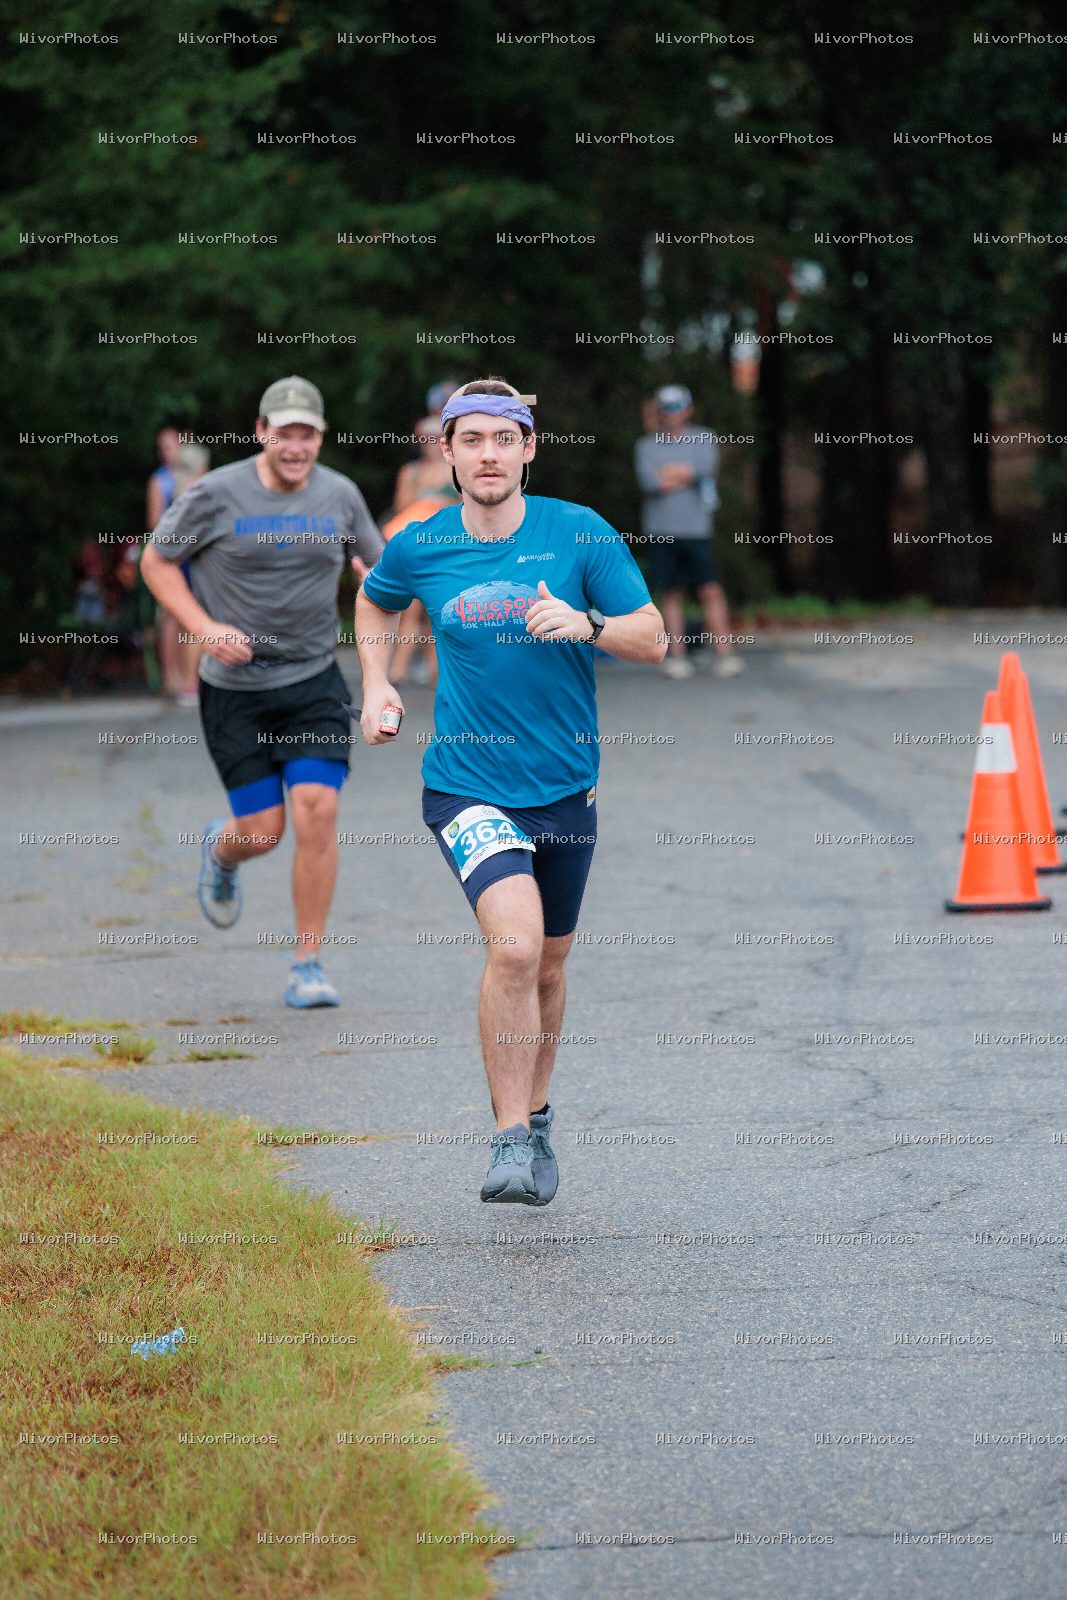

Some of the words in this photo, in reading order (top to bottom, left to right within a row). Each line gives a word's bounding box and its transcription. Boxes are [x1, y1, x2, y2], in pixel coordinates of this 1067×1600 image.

[466, 596, 539, 614] TUCSON
[467, 609, 528, 622] MARATHO
[461, 622, 479, 630] 50K
[484, 619, 507, 628] HALF
